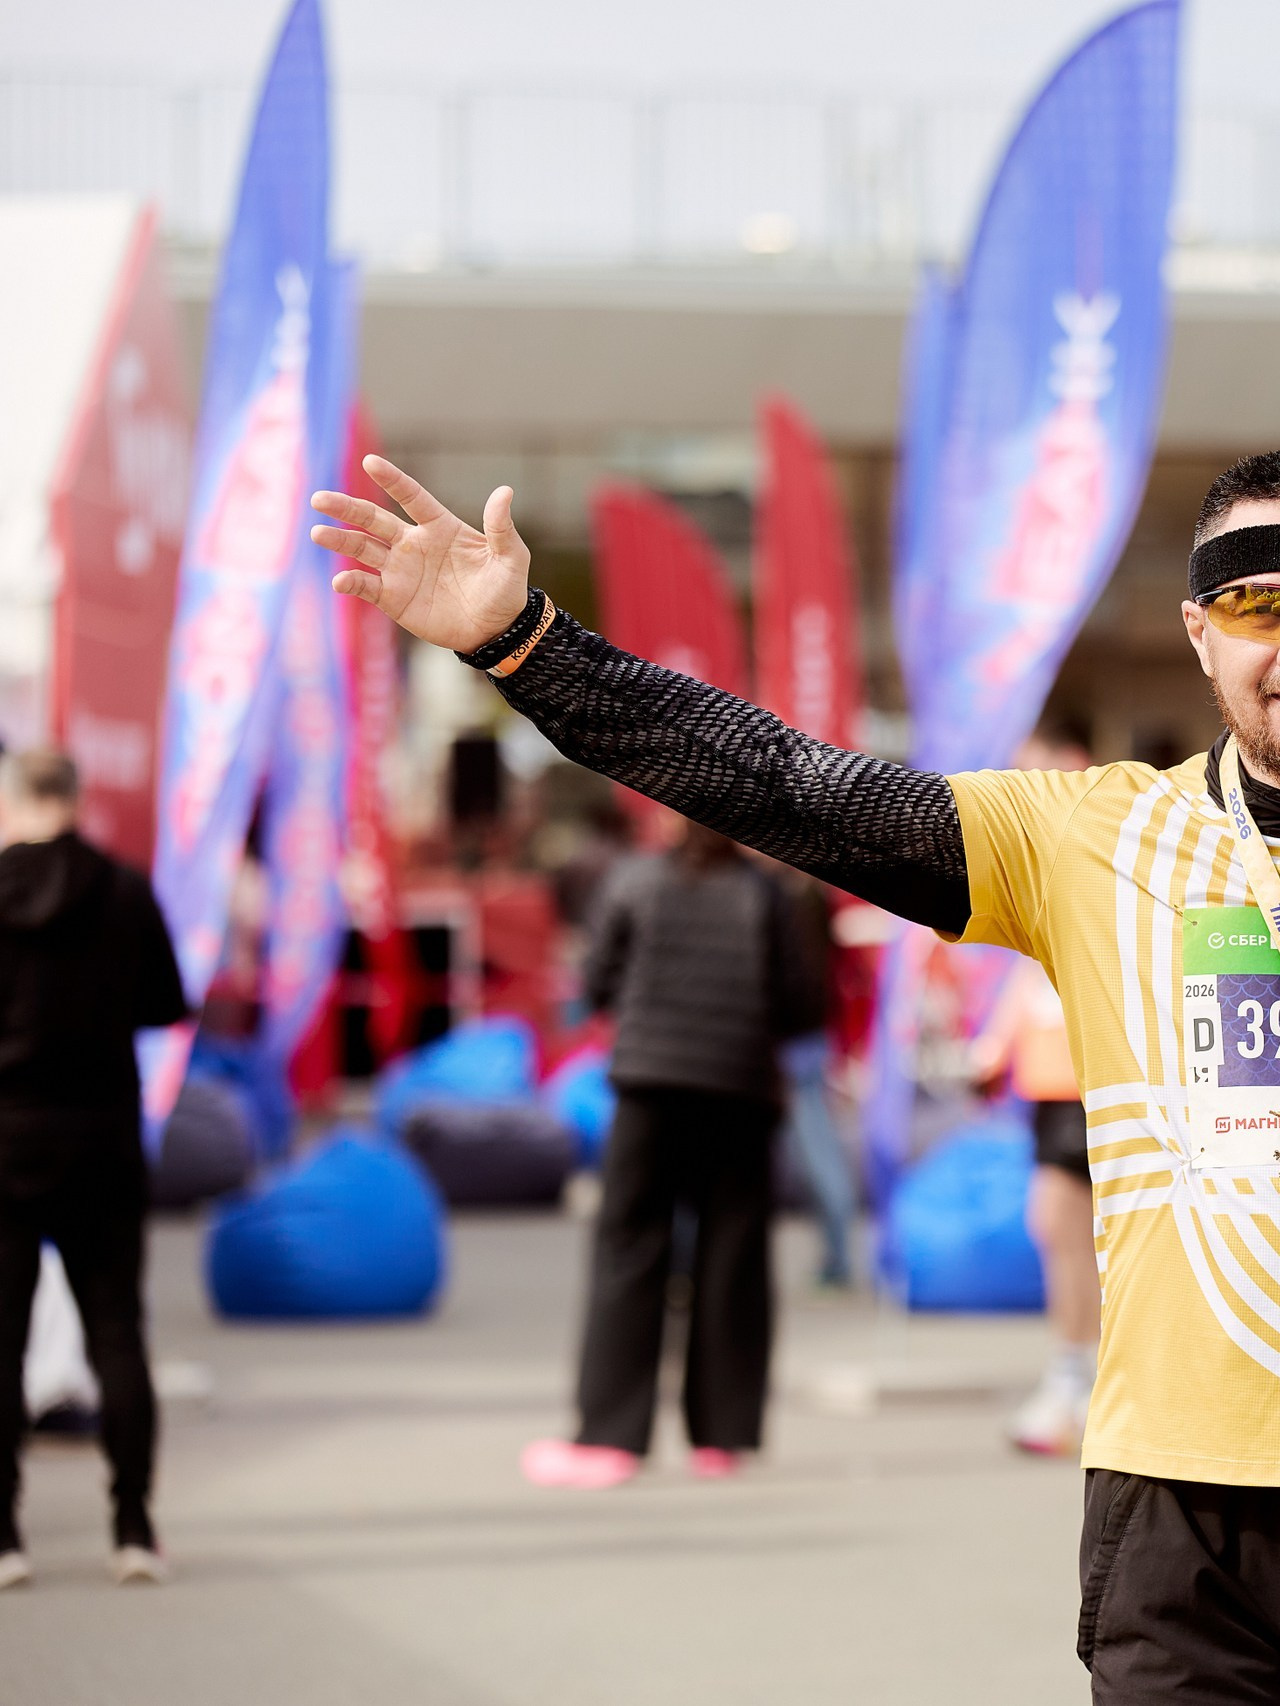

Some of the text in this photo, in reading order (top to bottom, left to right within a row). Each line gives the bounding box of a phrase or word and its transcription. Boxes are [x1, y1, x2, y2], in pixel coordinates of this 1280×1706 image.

[1228, 787, 1251, 840] 2026
[1228, 935, 1267, 946] СБЕР
[1185, 984, 1215, 998] 2026
[1193, 1017, 1215, 1052] D
